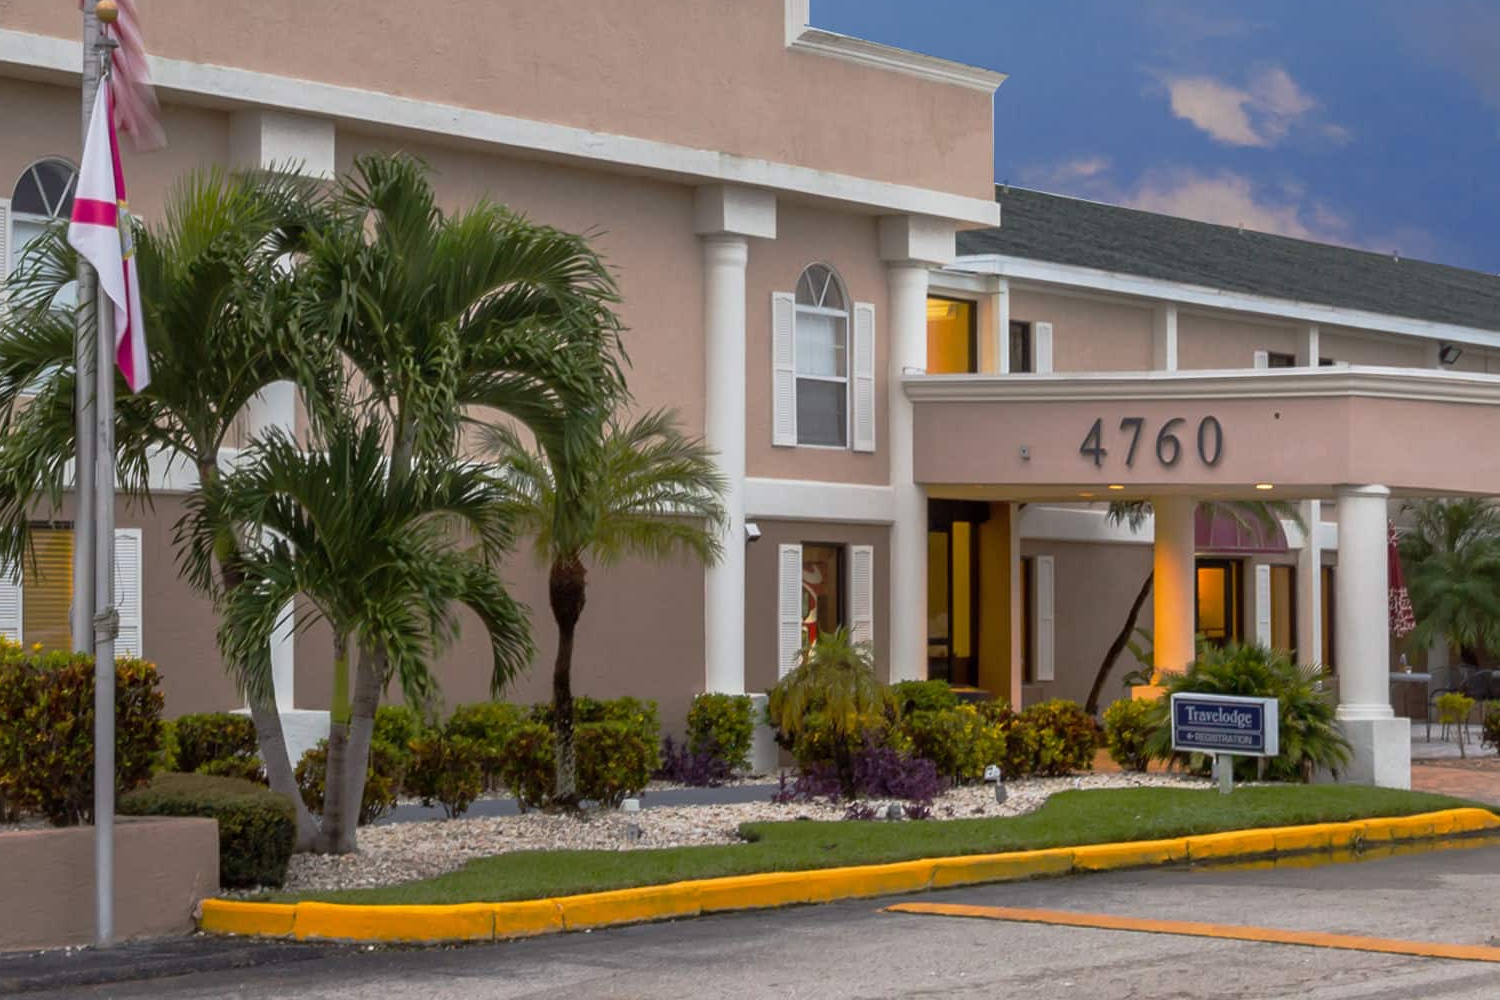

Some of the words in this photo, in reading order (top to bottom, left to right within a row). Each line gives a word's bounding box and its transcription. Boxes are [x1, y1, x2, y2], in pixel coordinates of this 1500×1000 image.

[1080, 416, 1222, 468] 4760
[1185, 705, 1252, 728] Travelodge
[1195, 732, 1252, 745] REGISTRATION
